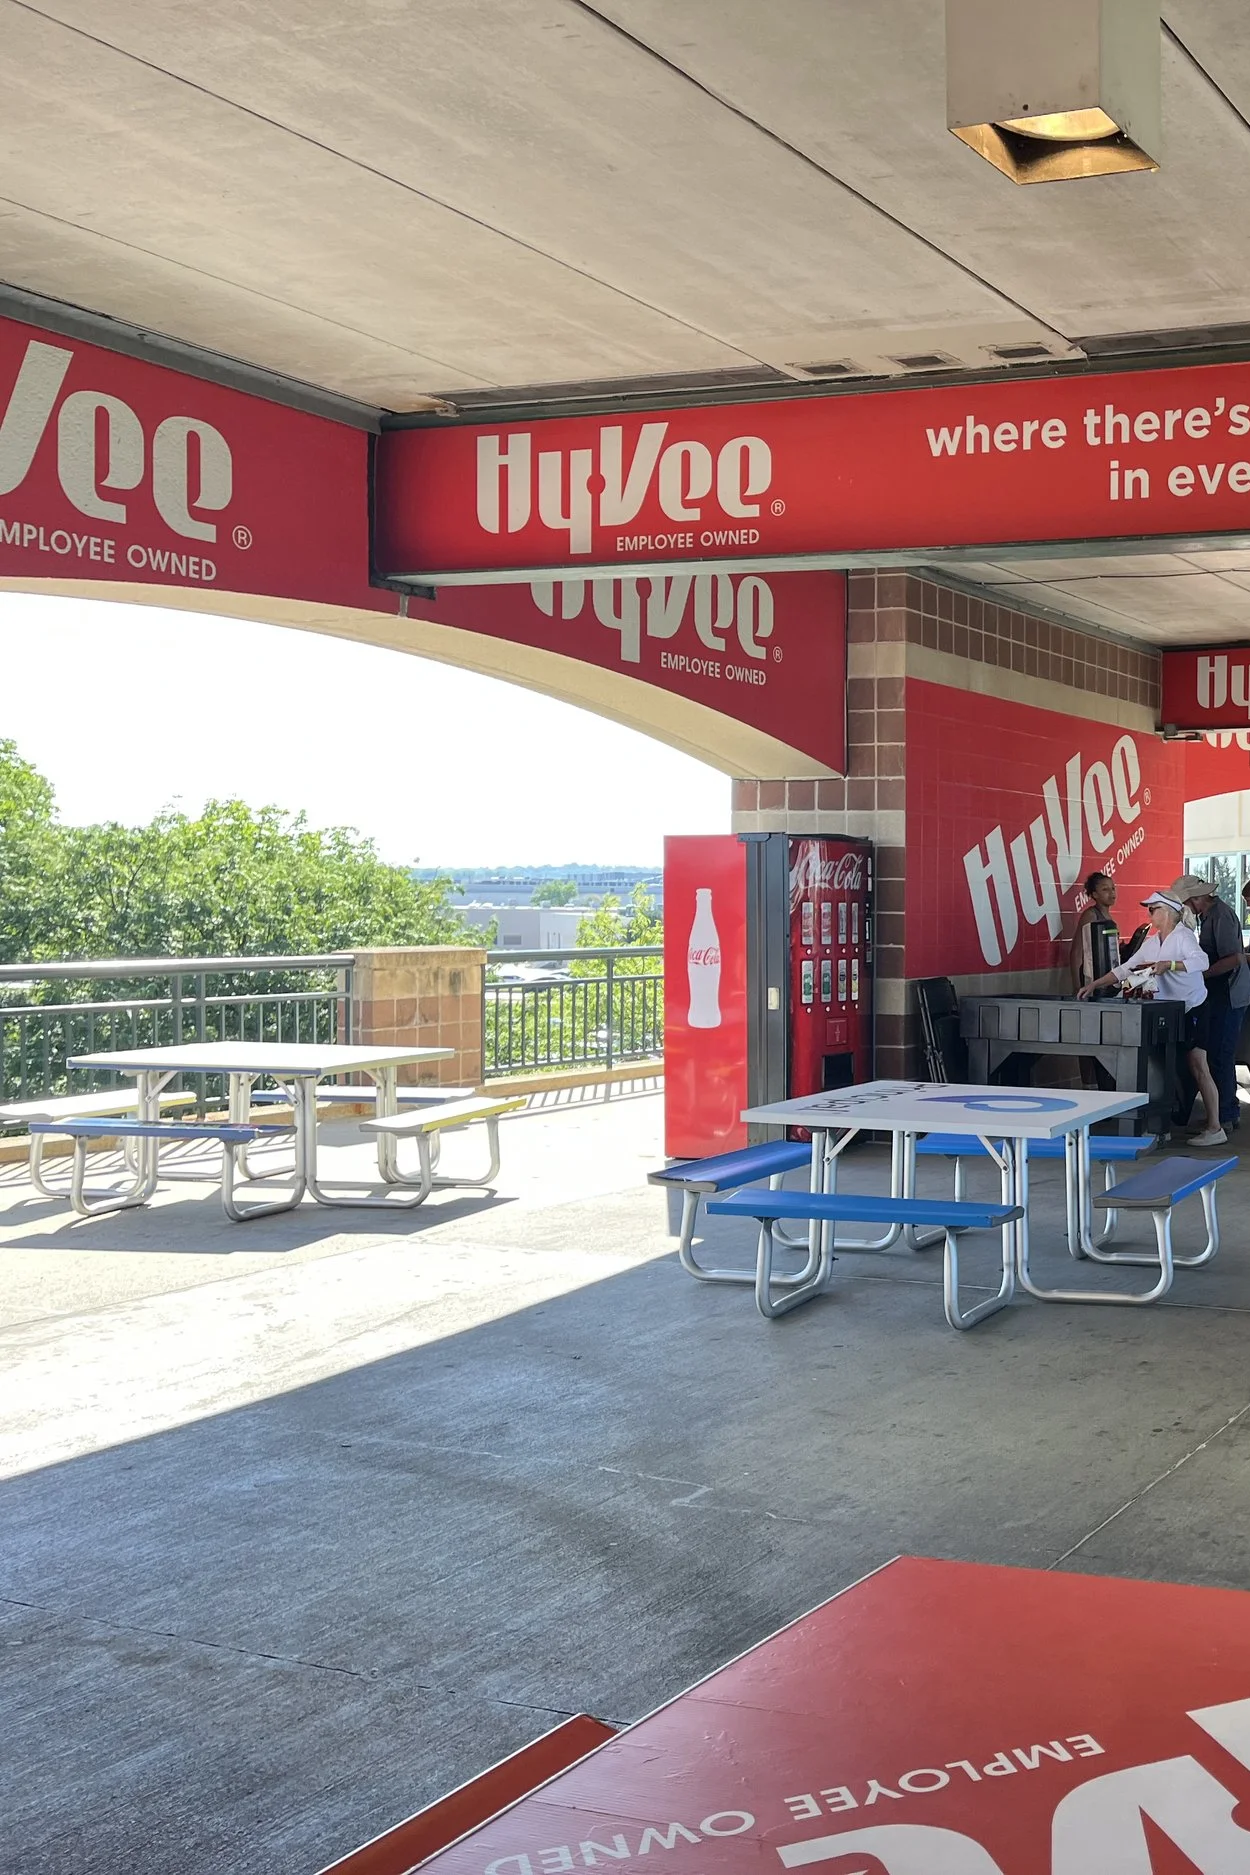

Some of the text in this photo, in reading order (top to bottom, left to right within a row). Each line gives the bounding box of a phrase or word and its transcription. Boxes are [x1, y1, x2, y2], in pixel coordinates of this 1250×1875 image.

[0, 340, 233, 543] Vee
[926, 420, 1067, 457] where
[1083, 397, 1250, 446] there's
[476, 422, 772, 554] HyVee
[1109, 460, 1150, 500] in
[0, 519, 217, 581] MPLOYEE OWNED
[616, 529, 760, 551] EMPLOYEE OWNED
[661, 652, 767, 686] EMPLOYEE OWNED
[963, 734, 1141, 966] HyVee
[1117, 827, 1145, 865] OWNED
[484, 1733, 1106, 1875] EMPLOYEE OWNED
